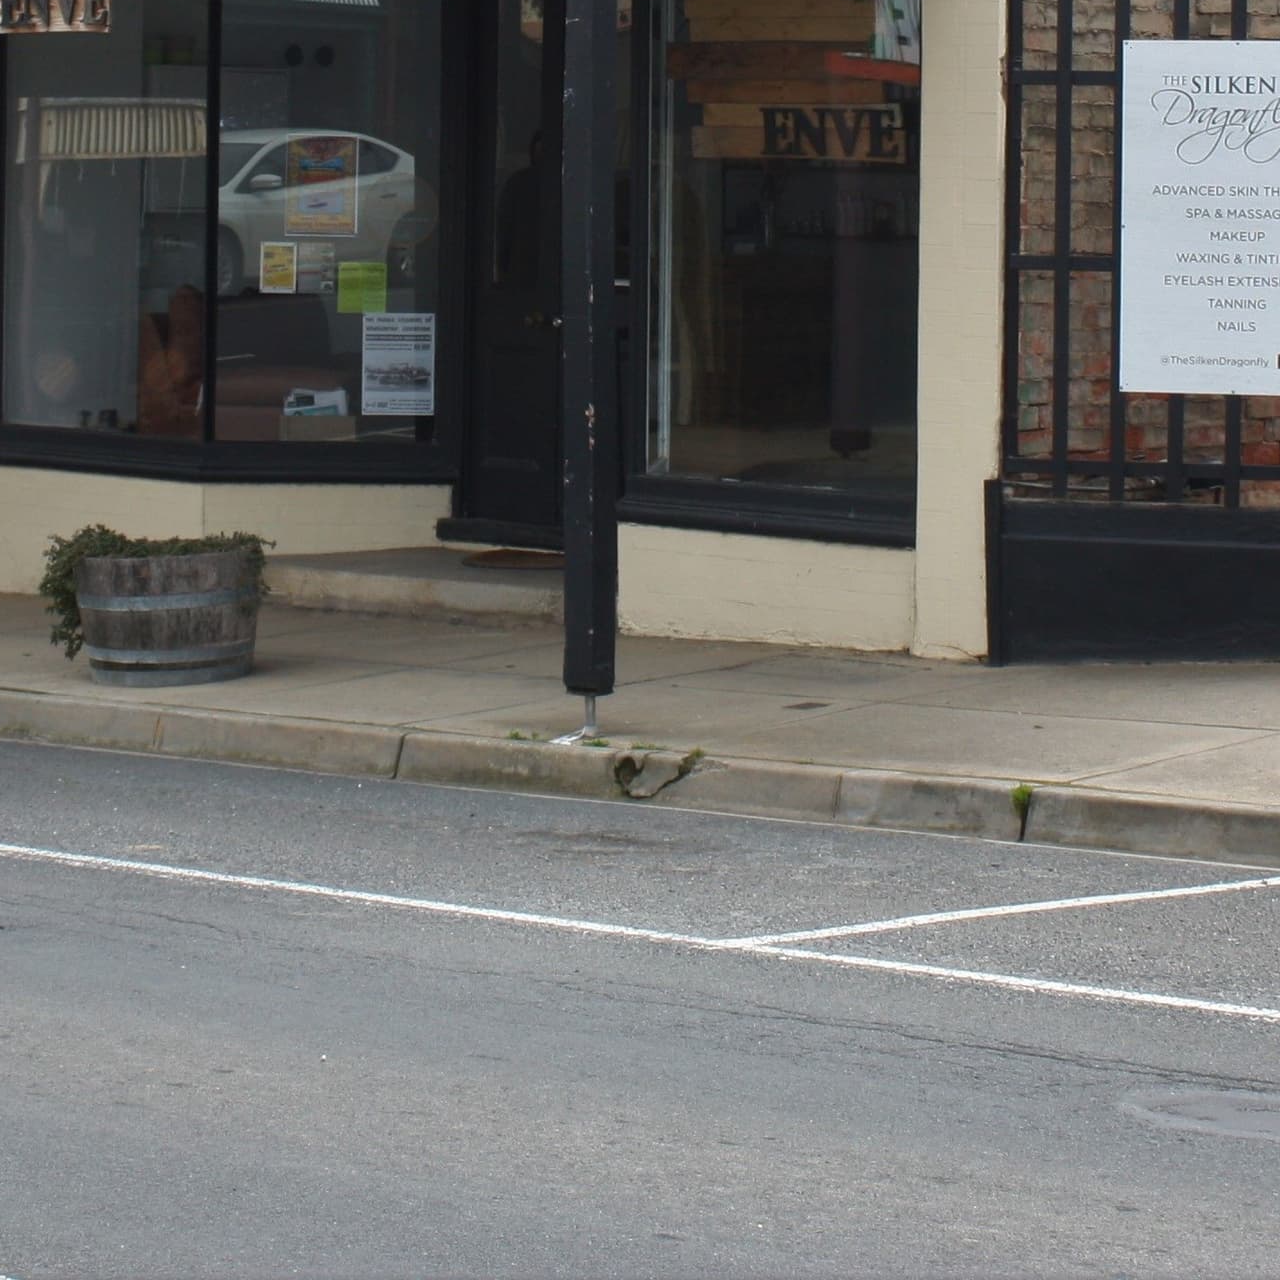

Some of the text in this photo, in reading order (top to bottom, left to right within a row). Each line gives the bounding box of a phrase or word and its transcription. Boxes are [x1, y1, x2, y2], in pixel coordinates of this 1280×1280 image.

[1162, 75, 1277, 94] THE SILKEN
[759, 107, 904, 158] ENVE
[1152, 185, 1225, 196] ADVANCED
[1229, 186, 1259, 197] SKIN
[1186, 208, 1210, 218] SPA
[1214, 208, 1223, 219] &
[1210, 231, 1265, 242] MAKEUP
[1176, 253, 1230, 264] WAXING
[1234, 254, 1242, 265] &
[1164, 275, 1223, 286] EYELASH
[1208, 298, 1266, 309] TANNING
[1218, 321, 1256, 332] NAILS
[1161, 355, 1269, 367] @TheSilkenDragonfly
